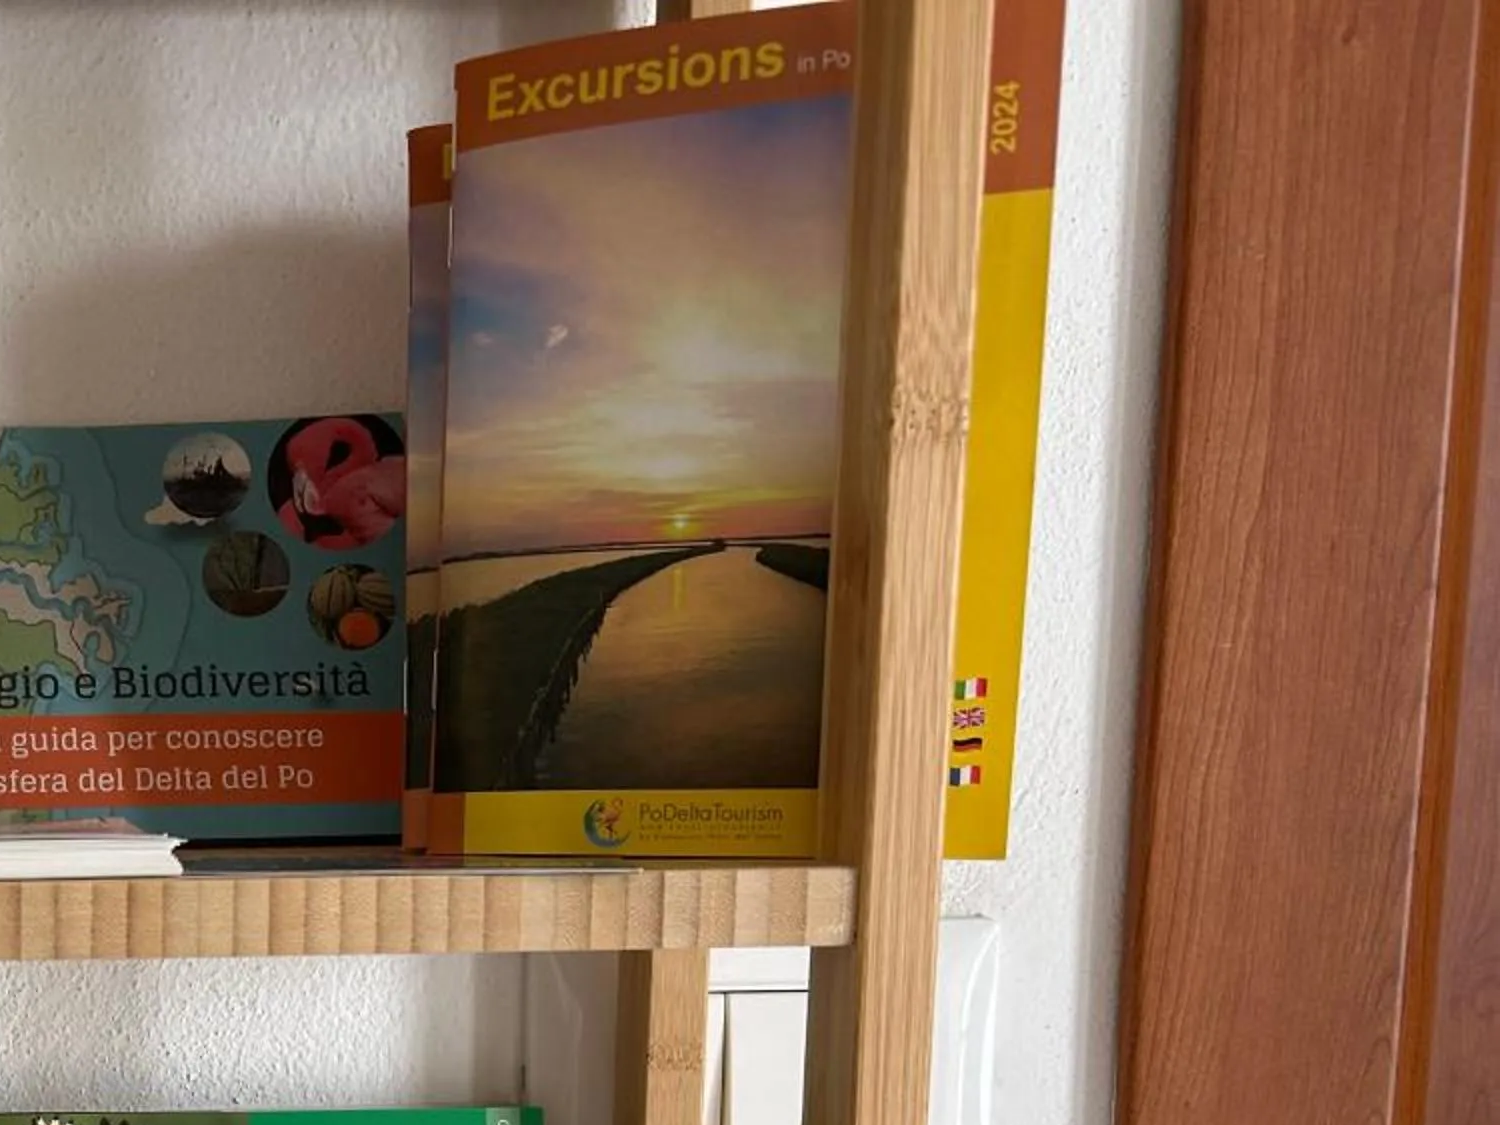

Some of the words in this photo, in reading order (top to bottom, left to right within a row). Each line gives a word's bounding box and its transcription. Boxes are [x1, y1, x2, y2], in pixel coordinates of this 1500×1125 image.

[487, 41, 786, 121] Excursions
[797, 53, 815, 74] in
[991, 81, 1021, 155] 2024
[74, 673, 97, 700] e
[113, 663, 370, 700] Biodiversità
[11, 726, 98, 758] guida
[107, 731, 157, 757] per
[166, 727, 324, 751] conoscere
[79, 767, 125, 794] del
[135, 766, 212, 792] Delta
[222, 764, 267, 790] del
[278, 764, 314, 789] Po
